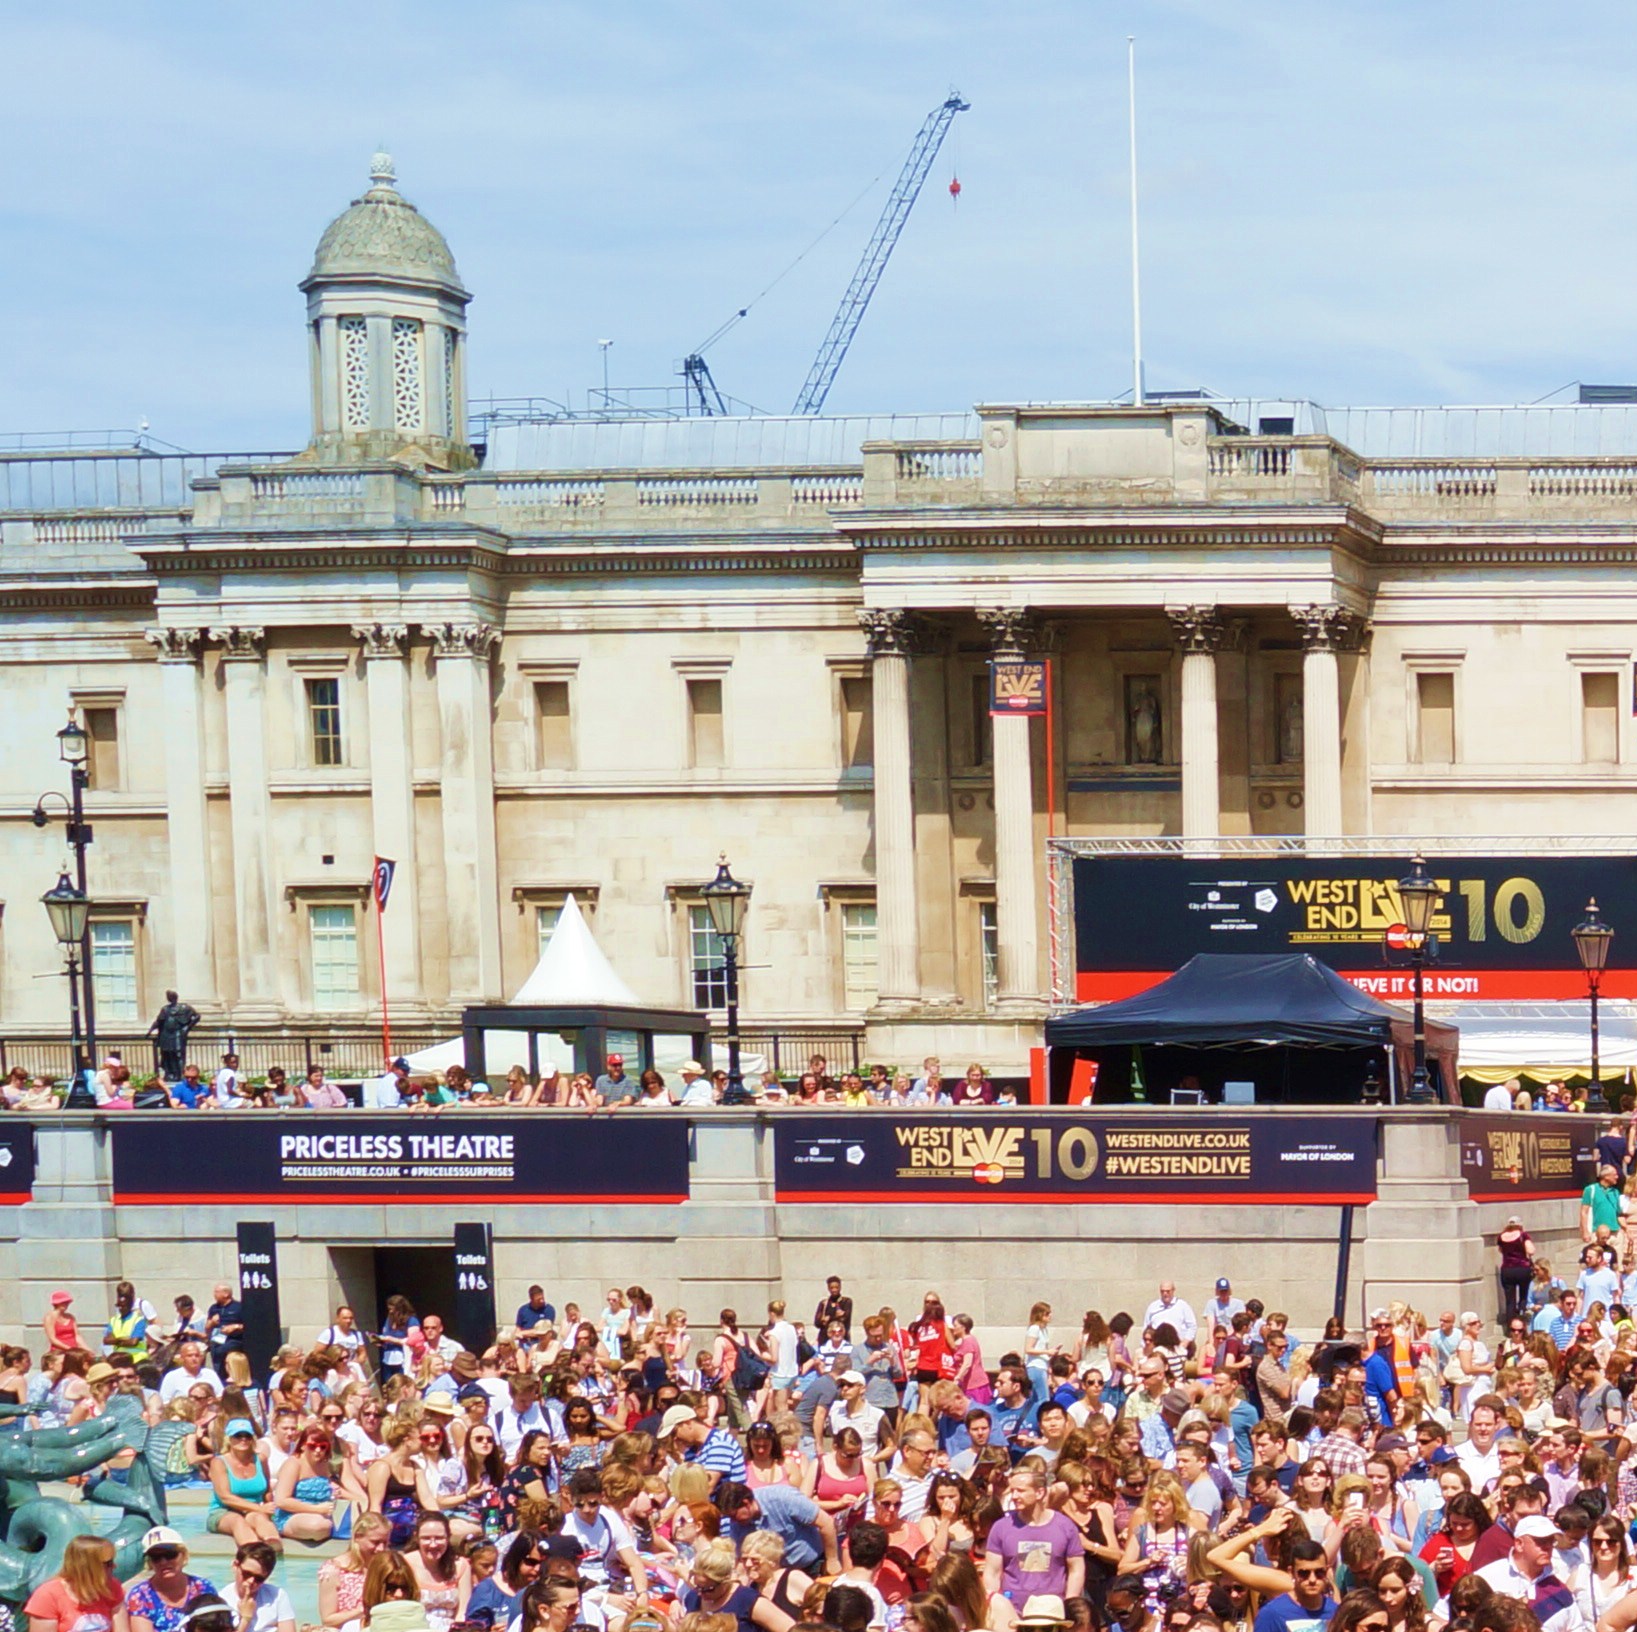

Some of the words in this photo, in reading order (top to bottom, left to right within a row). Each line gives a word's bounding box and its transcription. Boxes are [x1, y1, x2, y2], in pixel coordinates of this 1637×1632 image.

[996, 674, 1042, 698] LIVE
[1287, 880, 1357, 903] WEST
[1459, 877, 1546, 943] 10
[1308, 906, 1358, 929] END
[1391, 978, 1406, 992] IT
[1437, 977, 1479, 992] NOT!
[281, 1135, 403, 1159] PRICELESS
[408, 1135, 514, 1159] THEATRE
[1106, 1134, 1250, 1148] WESTENDLIVE.CO.UK
[895, 1127, 949, 1146] WEST
[953, 1127, 1025, 1167] LIVE
[1031, 1127, 1099, 1181] 10
[911, 1148, 951, 1166] END
[1281, 1152, 1307, 1161] MAYOR
[1308, 1152, 1319, 1161] OF
[1320, 1152, 1354, 1161] LONDON
[282, 1166, 401, 1177] PRICELESSTHEATRE.CO.UK
[1106, 1156, 1250, 1174] #WESTENDLIVE
[240, 1253, 271, 1264] Toilets
[456, 1254, 486, 1265] Toilets
